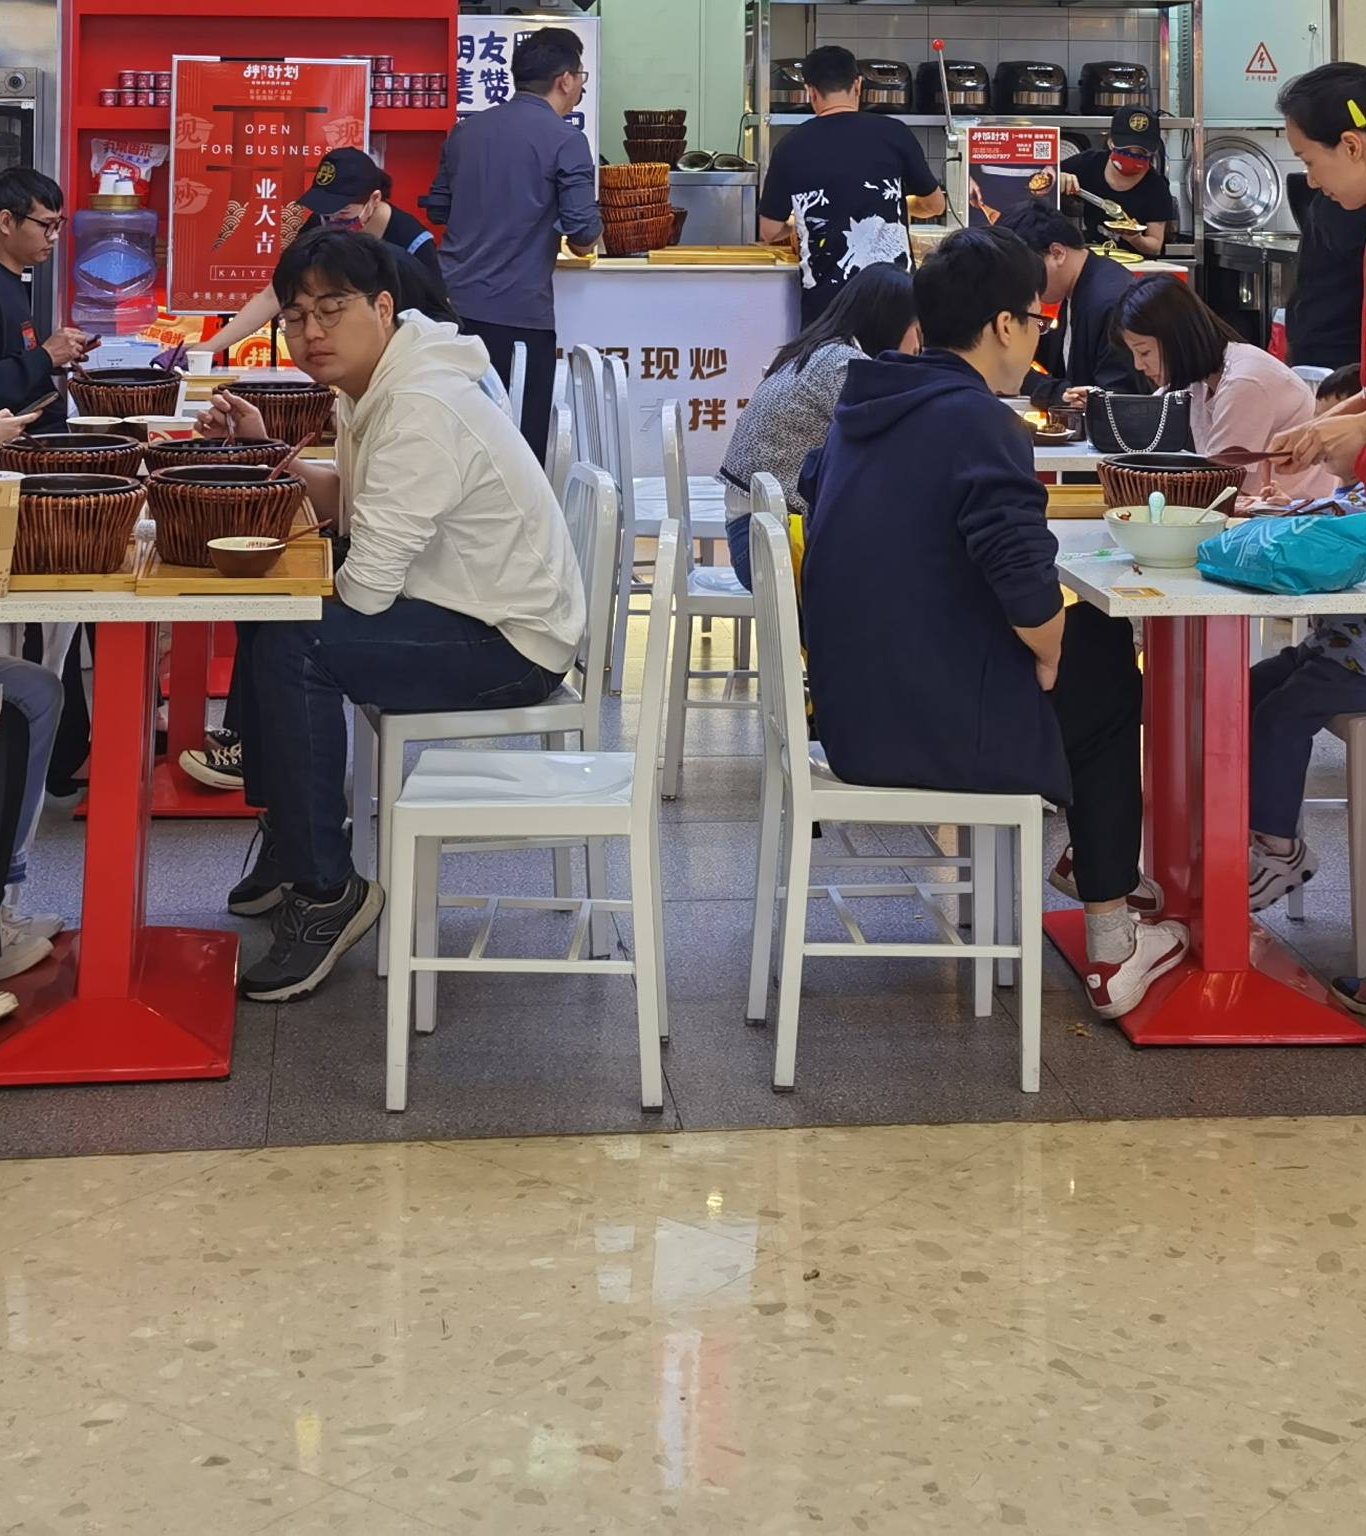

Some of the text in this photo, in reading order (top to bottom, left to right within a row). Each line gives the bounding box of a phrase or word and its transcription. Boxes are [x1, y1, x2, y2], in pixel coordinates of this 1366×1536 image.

[245, 124, 291, 135] OPEN
[200, 144, 333, 156] FOR BUSINESS
[218, 270, 268, 278] KAIYE
